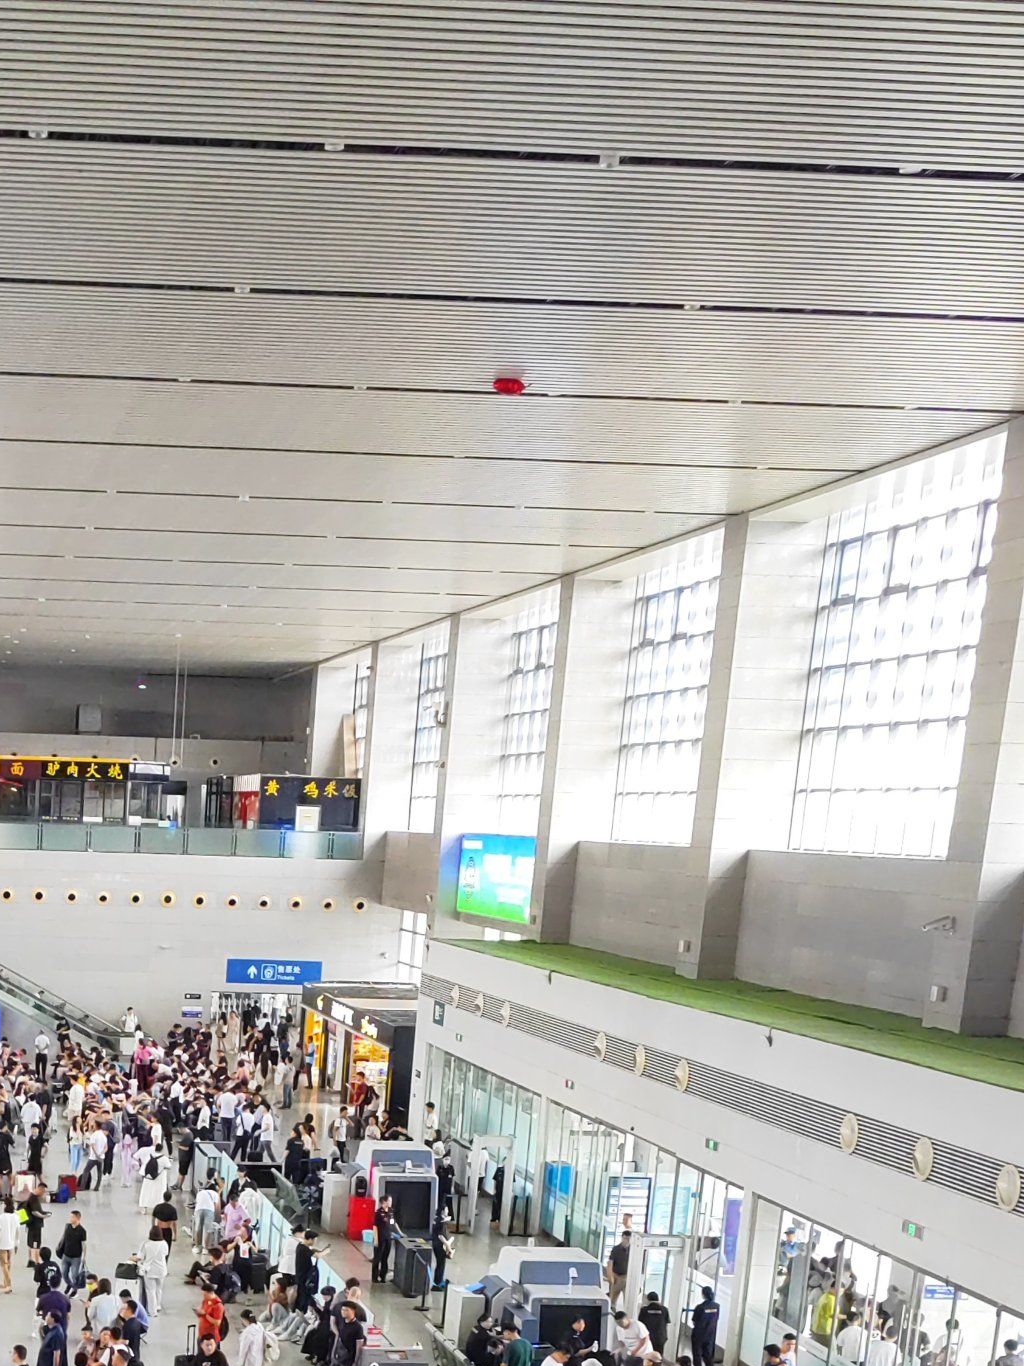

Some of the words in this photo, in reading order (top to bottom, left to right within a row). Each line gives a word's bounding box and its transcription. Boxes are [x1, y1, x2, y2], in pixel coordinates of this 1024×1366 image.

[46, 761, 124, 780] 驴肉火烧
[264, 778, 359, 799] 黄鸡米饭
[277, 965, 301, 974] 售票处
